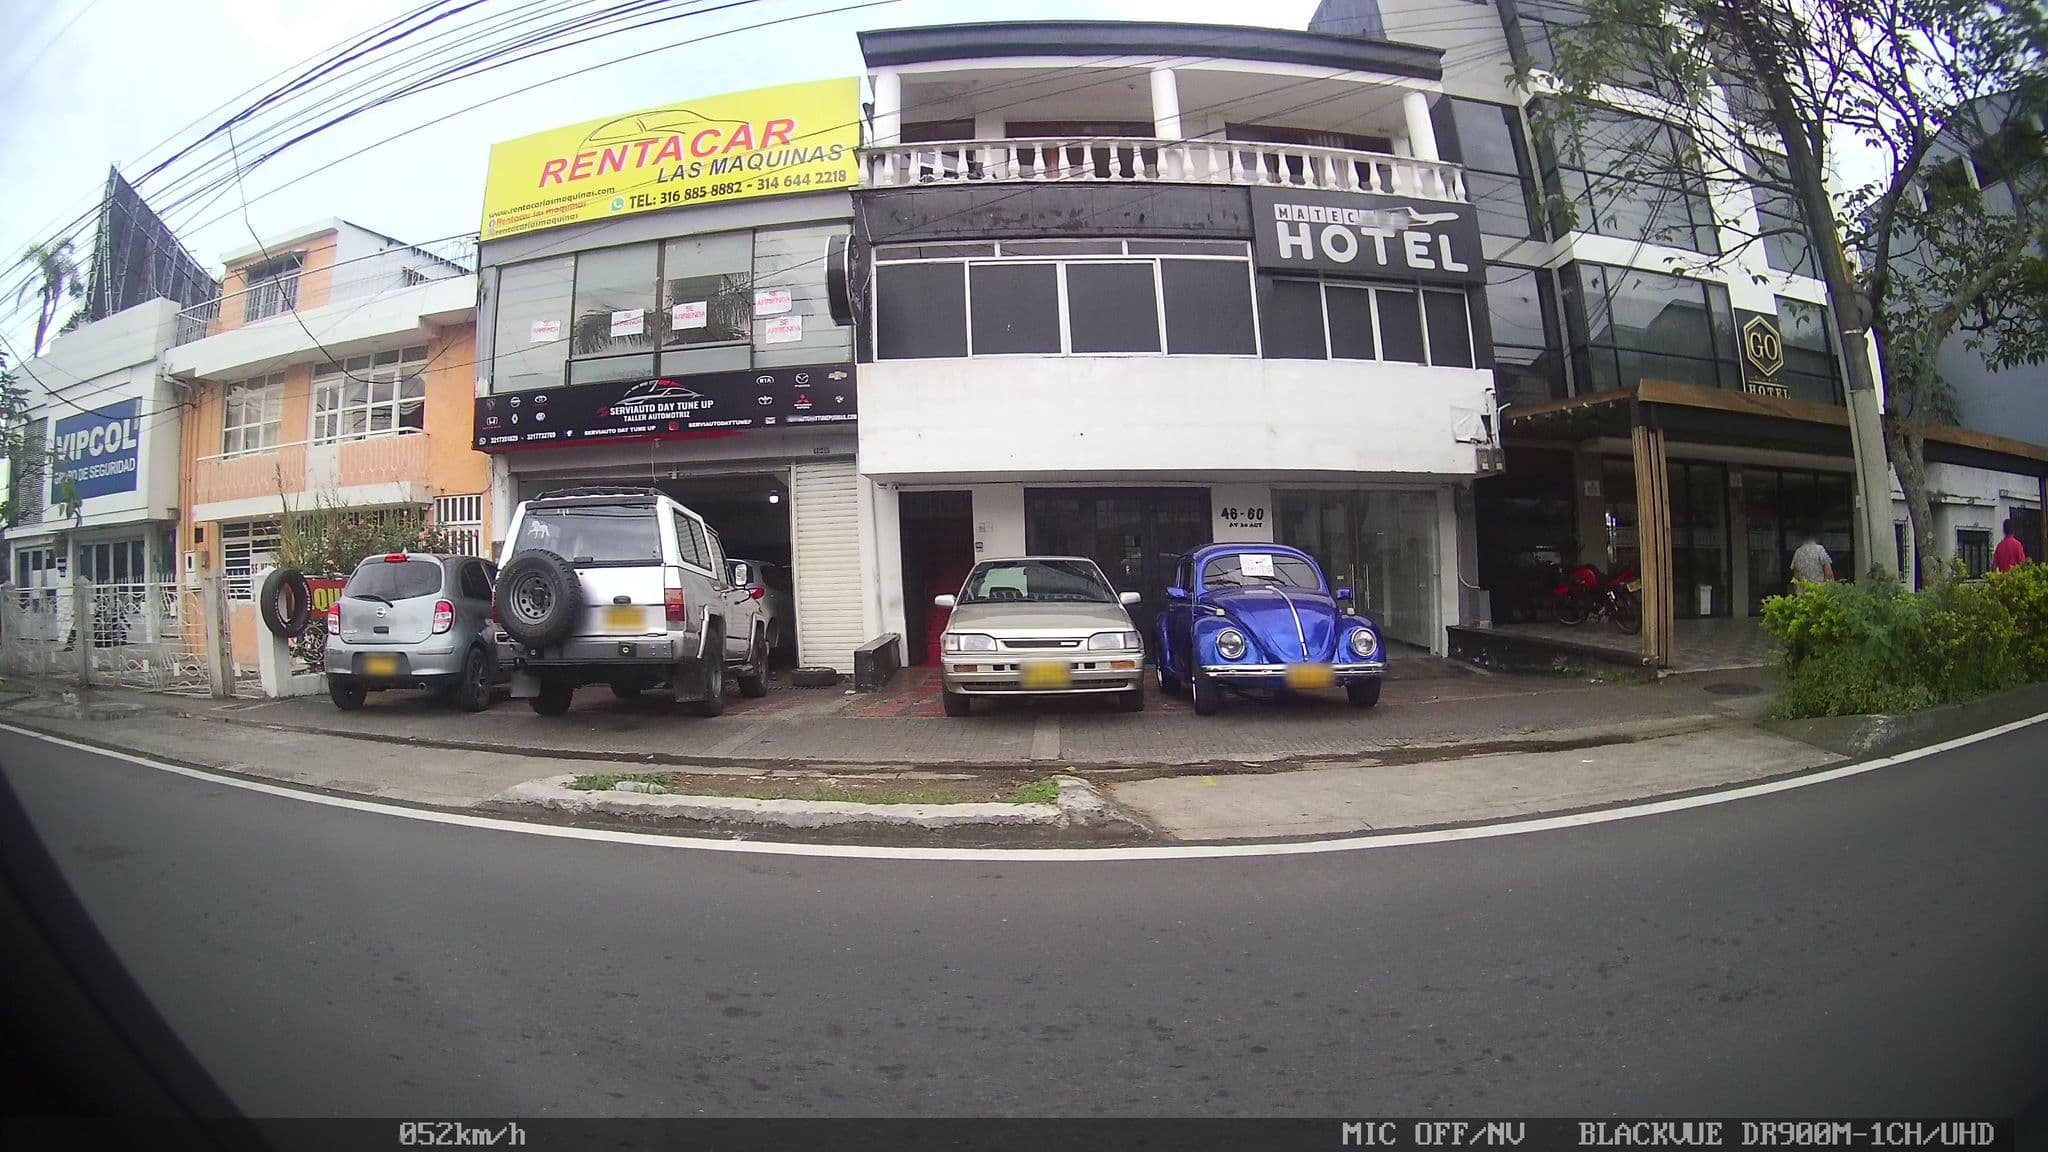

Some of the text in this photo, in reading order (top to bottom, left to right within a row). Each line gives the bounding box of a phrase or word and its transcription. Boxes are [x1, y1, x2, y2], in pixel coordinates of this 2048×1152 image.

[538, 118, 796, 188] RENTACAR
[656, 144, 844, 184] LAS MAQUINAS
[629, 194, 657, 209] TEL:
[660, 190, 681, 204] 316
[684, 187, 708, 201] 885
[710, 182, 743, 197] 8882
[756, 176, 779, 191] 314
[783, 173, 811, 188] 644
[814, 169, 847, 184] 2218
[1276, 221, 1469, 273] HOTEL
[1751, 332, 1778, 360] GO
[610, 400, 714, 416] SERVIAUTO DAY TUNE UP
[1748, 384, 1791, 400] HOTEL
[624, 411, 691, 422] TALLER AUTOMOTRIZ
[56, 418, 137, 462] VIPCOL
[78, 467, 89, 481] DE
[89, 458, 136, 478] SEGURIDAD
